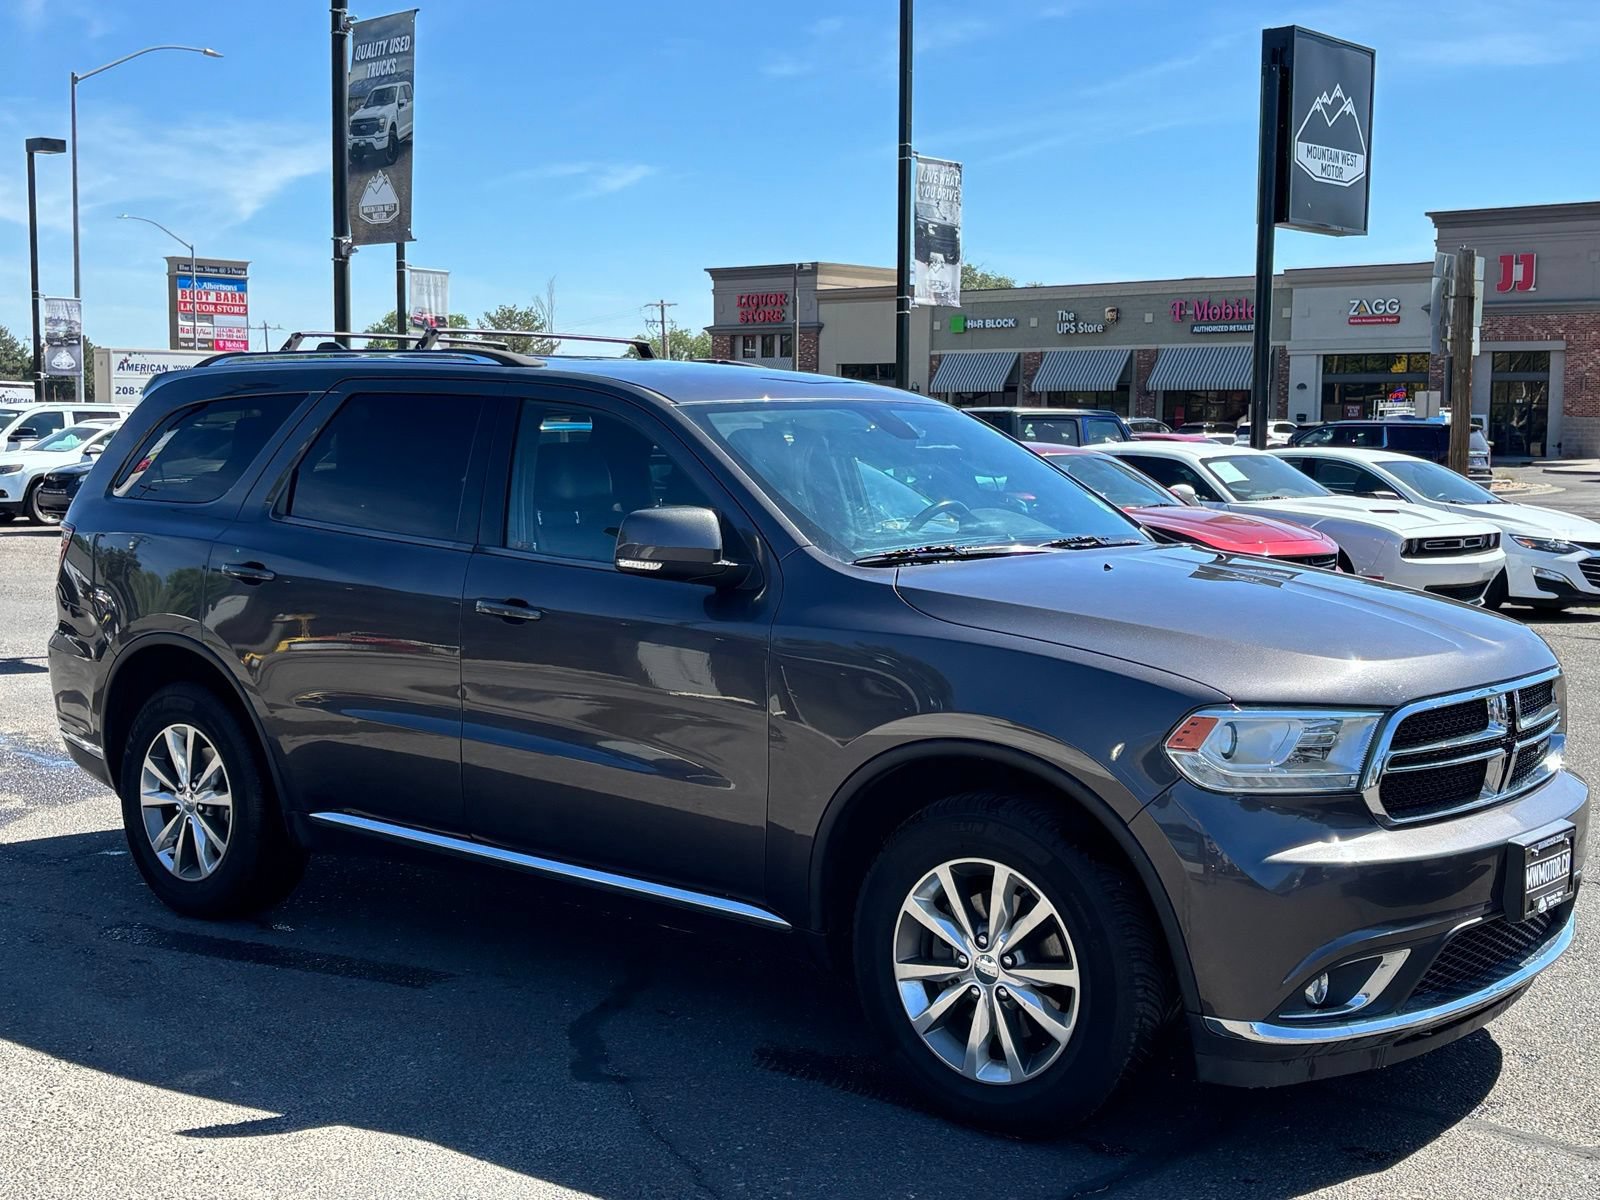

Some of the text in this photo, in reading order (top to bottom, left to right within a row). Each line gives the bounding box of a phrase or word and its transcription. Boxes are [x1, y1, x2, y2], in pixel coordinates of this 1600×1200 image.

[355, 34, 411, 61] QUALITY USED
[366, 57, 398, 79] TRUCKS
[1306, 145, 1358, 168] MOUNTAIN WEST
[1320, 163, 1344, 178] MOTOR
[920, 170, 960, 188] LOVE WHAT
[920, 184, 959, 202] YOU DRIVE
[202, 282, 237, 291] Albertsons
[180, 290, 246, 303] BOOT BARN
[736, 293, 785, 309] LIQUOR
[217, 305, 247, 314] STORE
[1348, 298, 1400, 316] ZAGG
[738, 309, 784, 323] STORE
[1057, 310, 1075, 321] The
[967, 318, 1016, 329] H&R BLOCK
[1057, 322, 1105, 335] UPS Store
[1193, 325, 1229, 333] AUTHORIZED
[117, 360, 168, 372] AMERICAN
